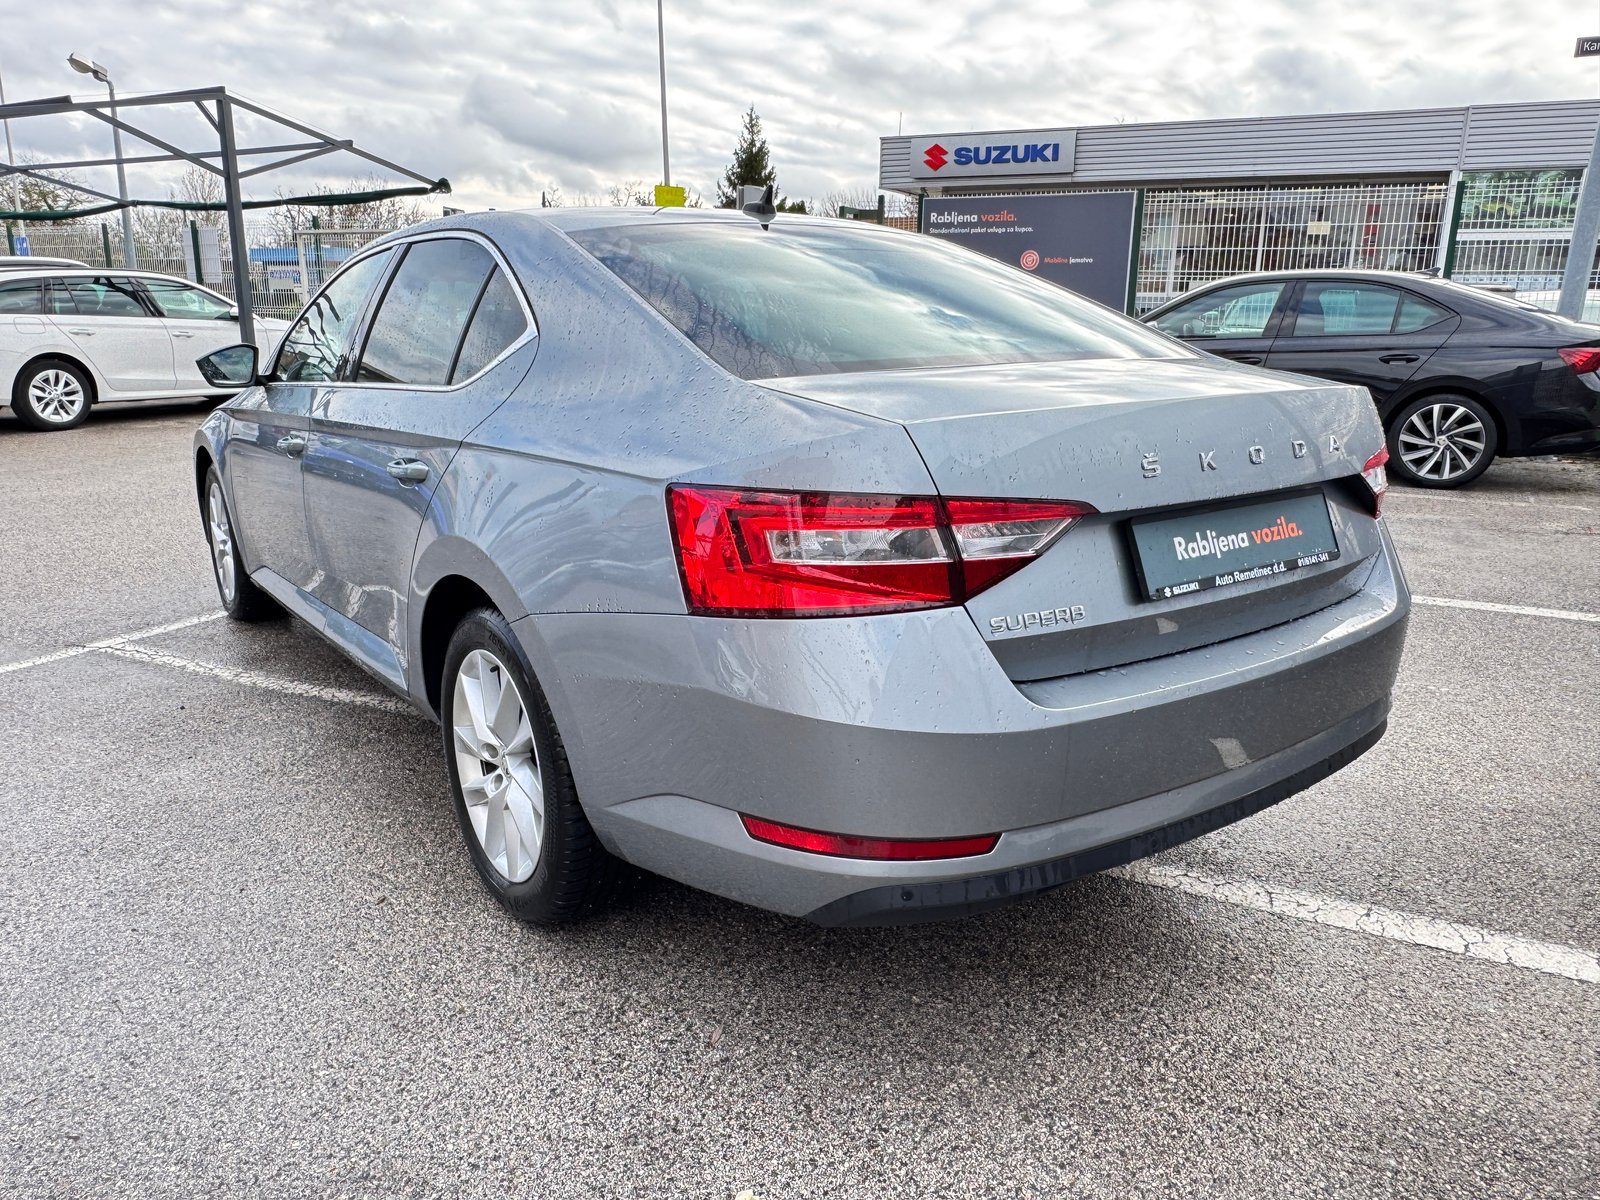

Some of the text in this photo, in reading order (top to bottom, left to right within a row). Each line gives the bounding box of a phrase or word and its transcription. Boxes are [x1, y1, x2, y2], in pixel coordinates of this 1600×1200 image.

[953, 143, 1060, 166] SUZUKI
[930, 210, 1017, 225] Rabljena vozila.
[970, 226, 987, 234] paket
[1141, 435, 1341, 478] ŠKODA
[1173, 516, 1303, 560] Rabljena vozila.
[1172, 582, 1200, 595] SUZUKI
[1215, 575, 1234, 586] Auto
[1233, 566, 1273, 582] Remetinec
[1273, 561, 1287, 573] d.d.
[989, 605, 1086, 634] SUPERB
